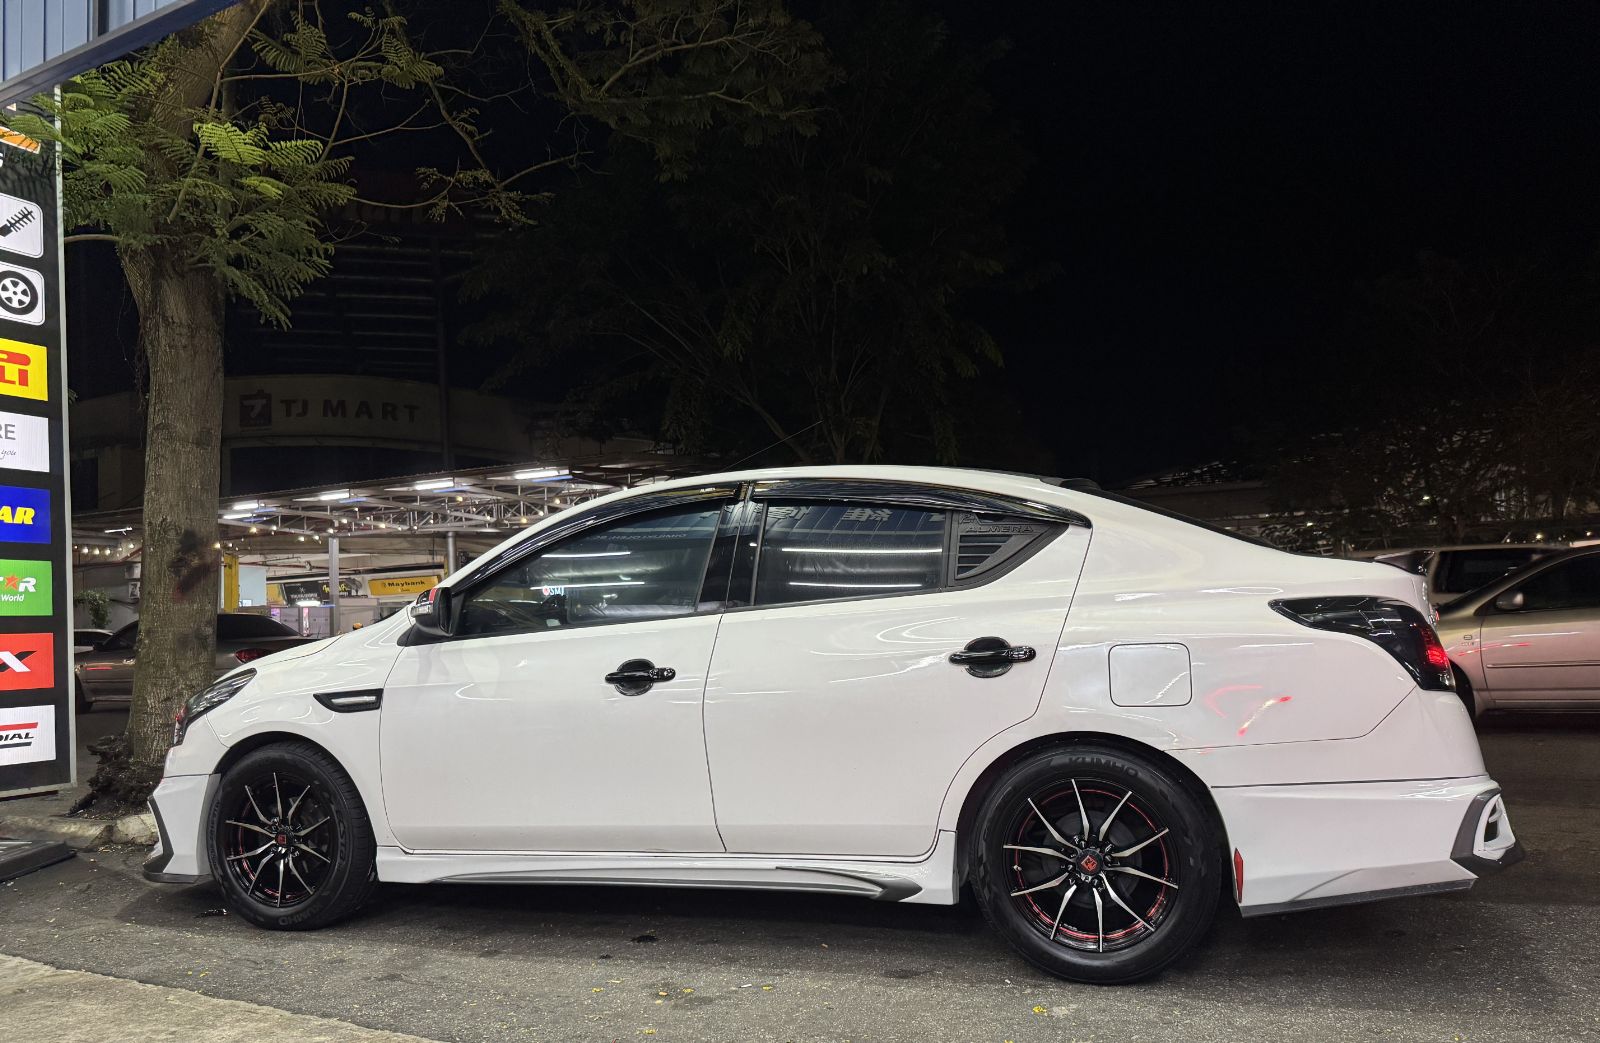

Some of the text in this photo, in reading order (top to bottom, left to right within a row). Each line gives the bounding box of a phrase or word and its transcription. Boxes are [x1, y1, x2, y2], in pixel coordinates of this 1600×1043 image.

[280, 399, 421, 424] TJ MART
[966, 525, 1034, 534] ALMERA
[387, 580, 425, 588] Maybank
[1, 594, 25, 602] World
[1068, 756, 1139, 777] KUMHO
